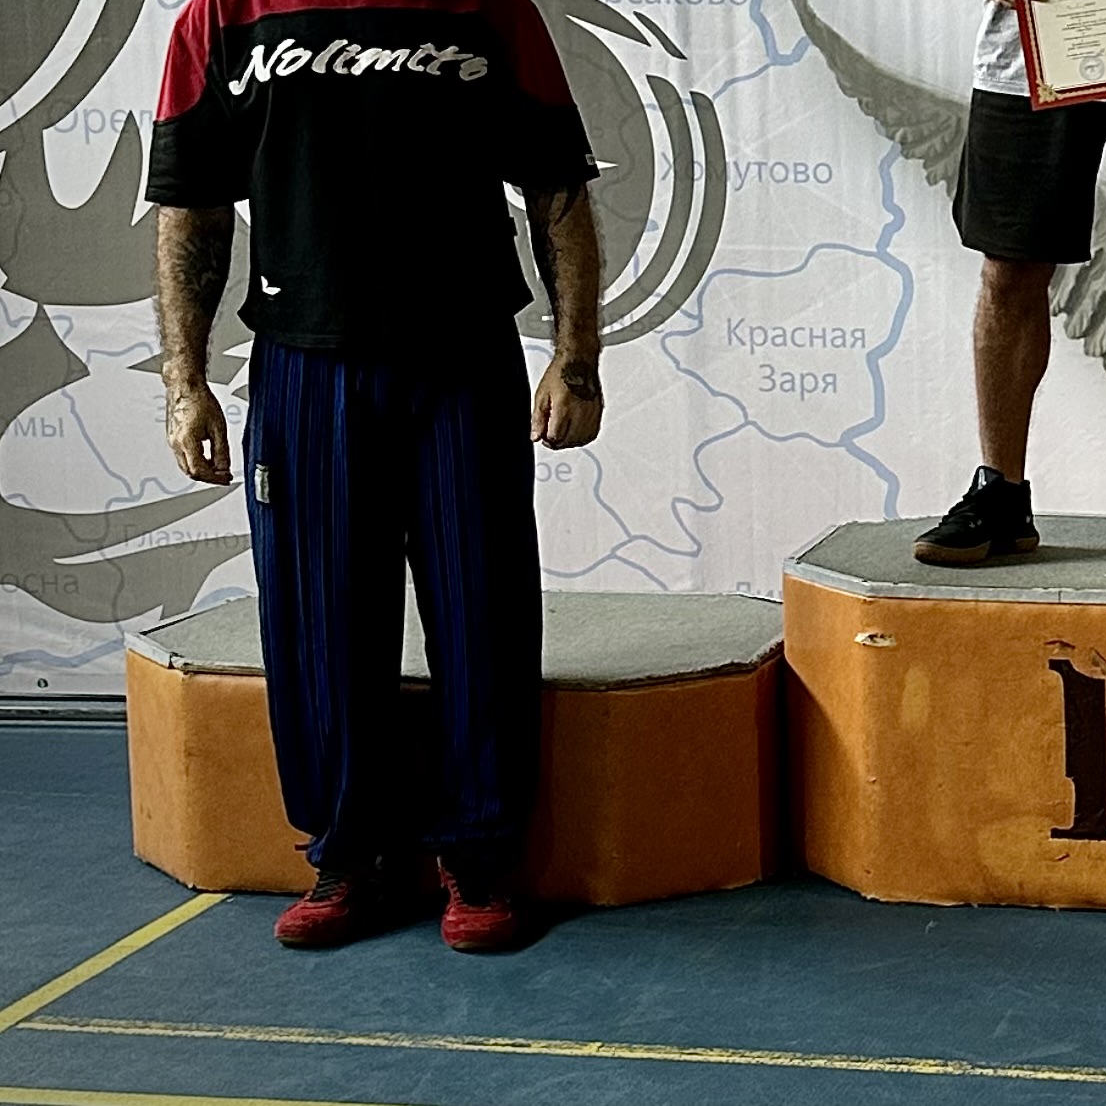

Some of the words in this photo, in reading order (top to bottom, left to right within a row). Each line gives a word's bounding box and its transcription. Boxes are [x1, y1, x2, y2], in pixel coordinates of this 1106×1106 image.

[726, 317, 866, 355] Красная
[758, 363, 838, 401] Заря
[1, 572, 81, 595] осна
